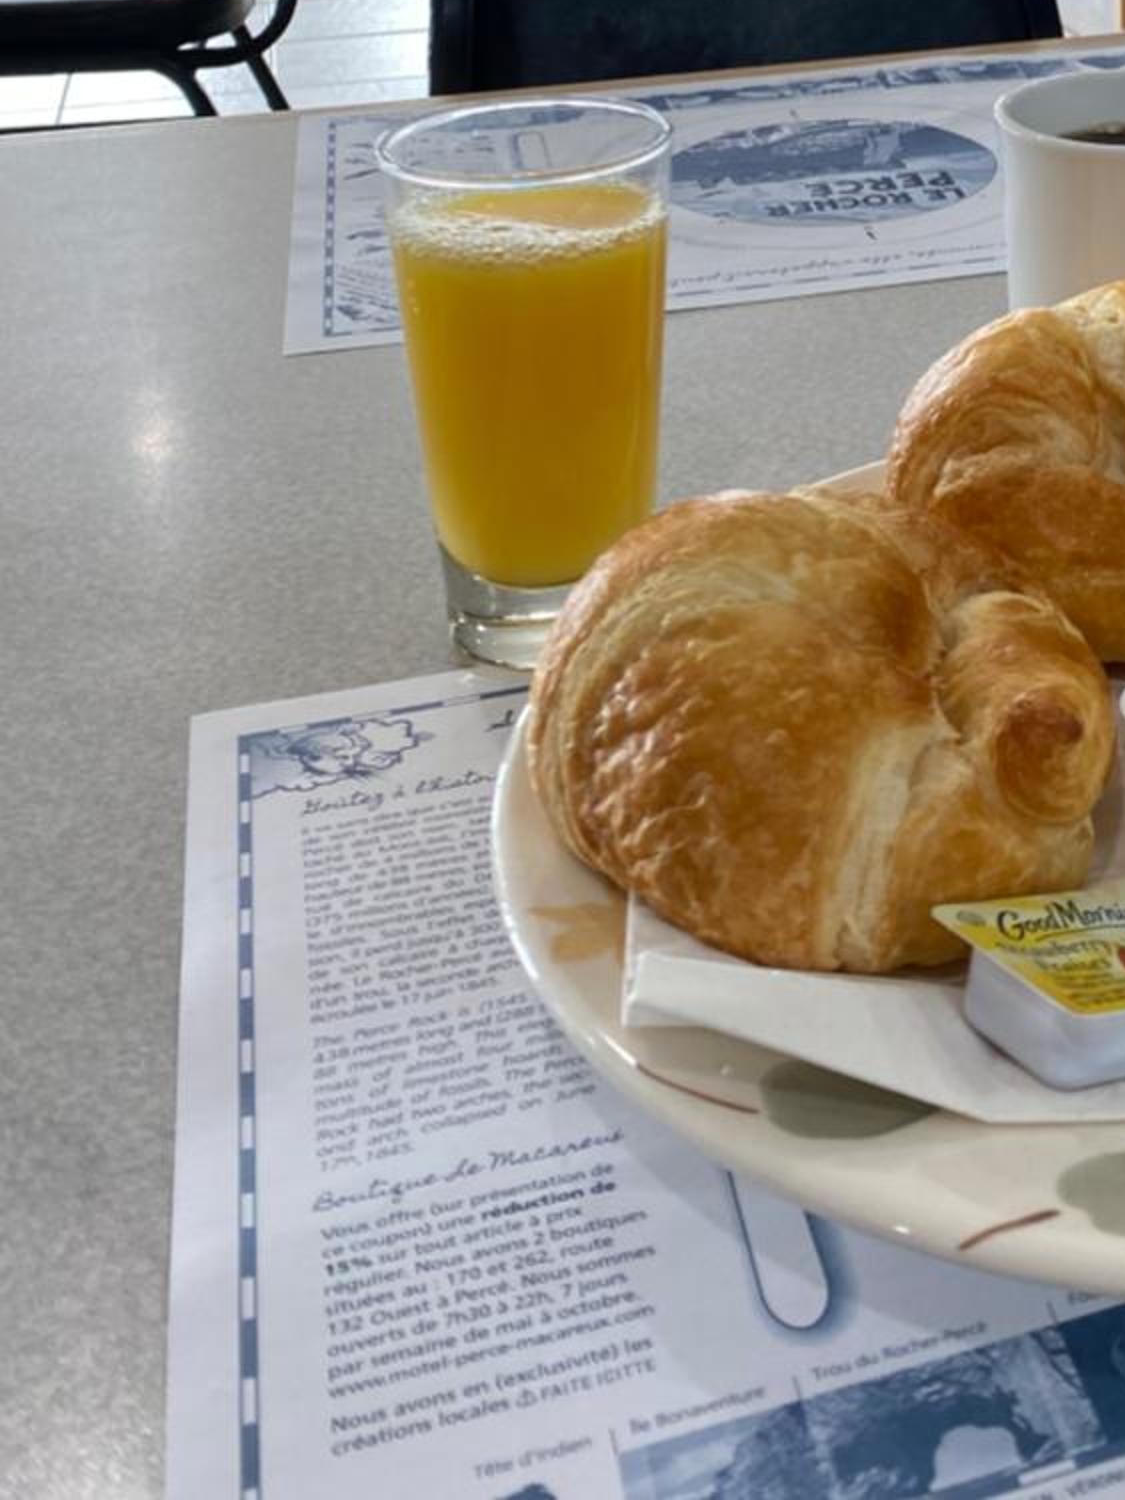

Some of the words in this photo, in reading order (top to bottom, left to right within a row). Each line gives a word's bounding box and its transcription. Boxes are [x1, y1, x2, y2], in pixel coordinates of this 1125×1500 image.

[765, 191, 915, 217] ROCHER
[416, 1025, 454, 1041] long
[421, 1102, 506, 1133] collapsed
[519, 1098, 541, 1110] on
[320, 1222, 368, 1242] Vous
[374, 1209, 423, 1229] offre
[430, 1199, 463, 1219] (sur
[470, 1170, 586, 1210] présentation
[591, 1162, 613, 1178] de
[322, 1245, 344, 1259] ce
[349, 1220, 431, 1252] coupon)
[437, 1214, 474, 1231] une
[481, 1188, 584, 1221] réduction
[591, 1179, 616, 1195] de
[325, 1253, 372, 1277] 15%
[377, 1249, 407, 1264] sur
[415, 1233, 456, 1255] tout
[463, 1219, 522, 1244] article
[529, 1213, 539, 1228] à
[546, 1205, 582, 1227] prix
[325, 1290, 395, 1316] situées
[402, 1283, 426, 1297] au
[446, 1265, 480, 1286] 170
[487, 1259, 506, 1276] et
[513, 1250, 553, 1270] 262,
[560, 1235, 613, 1258] route
[416, 1253, 465, 1274] Nous
[472, 1238, 527, 1260] avons
[534, 1230, 543, 1245] 2
[550, 1209, 646, 1241] boutiques
[327, 1315, 362, 1336] 132
[370, 1298, 430, 1325] Ouest
[437, 1293, 448, 1309] à
[521, 1267, 570, 1288] Nous
[577, 1246, 655, 1274] sommes
[327, 1327, 404, 1357] ouverts
[412, 1319, 438, 1336] de
[444, 1303, 490, 1328] 7h30
[497, 1299, 507, 1315] à
[561, 1283, 572, 1299] 7
[578, 1273, 627, 1298] jours
[327, 1360, 364, 1382] par
[370, 1336, 456, 1367] semaine
[463, 1328, 489, 1344] de
[495, 1313, 532, 1336] mai
[540, 1309, 551, 1325] à
[557, 1293, 639, 1320] octobre.
[811, 1359, 848, 1383] Trou
[854, 1351, 879, 1369] du
[331, 1409, 386, 1433] Nous
[394, 1391, 456, 1416] avons
[463, 1382, 488, 1398] en
[495, 1344, 618, 1393] (exclusivité)
[624, 1339, 652, 1356] les
[655, 1384, 767, 1433] Bonaventure
[331, 1420, 432, 1456] créations
[439, 1400, 509, 1428] locales
